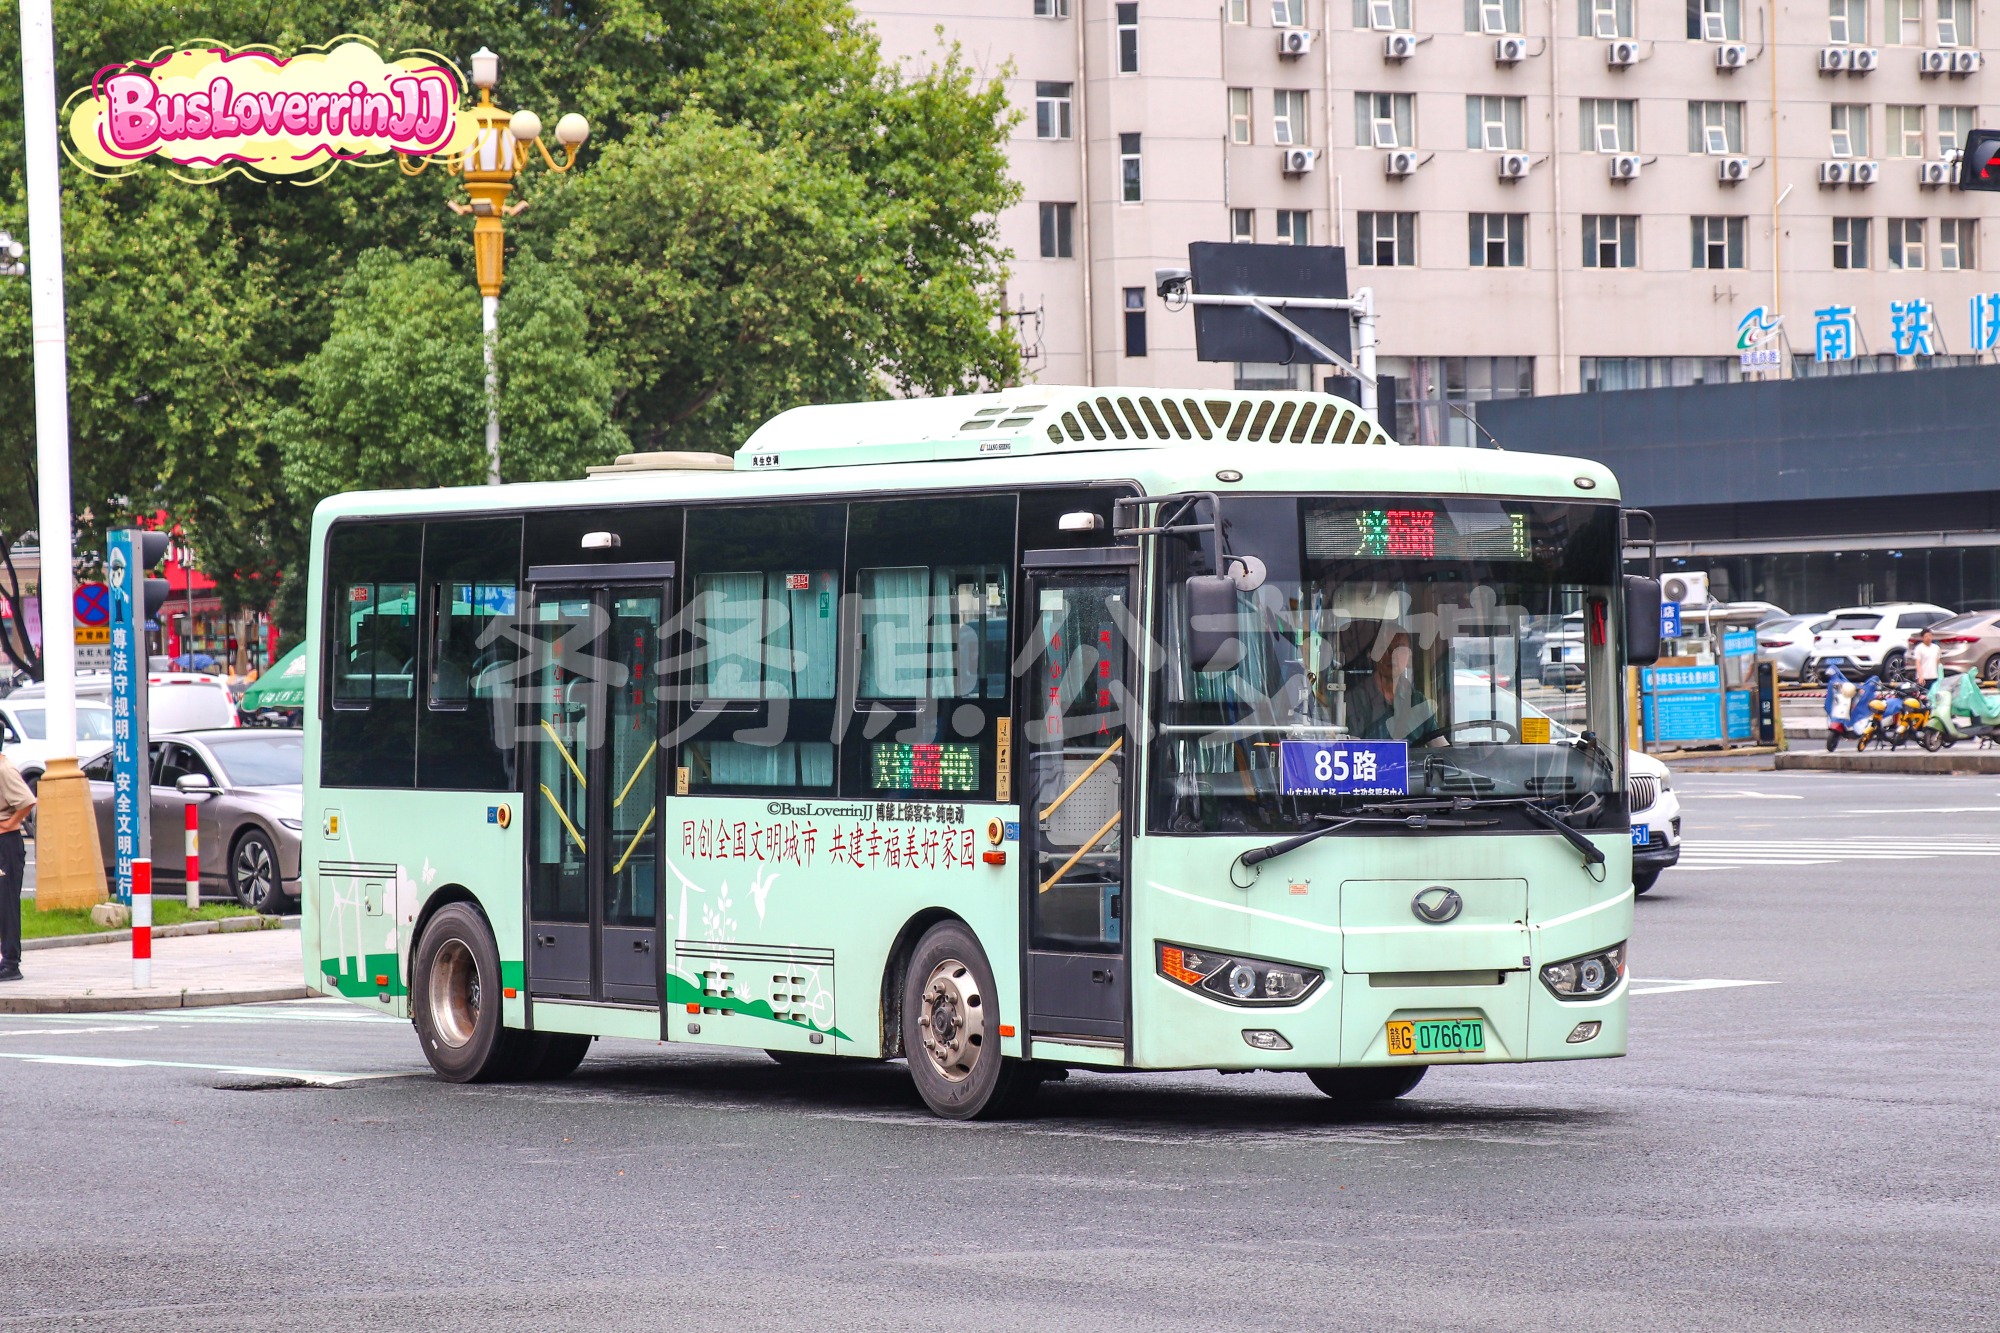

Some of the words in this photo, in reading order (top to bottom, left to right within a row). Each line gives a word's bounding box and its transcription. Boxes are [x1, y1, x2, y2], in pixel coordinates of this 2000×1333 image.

[752, 455, 779, 466] 良生空调
[112, 628, 130, 763] 尊法守规明礼
[1314, 750, 1377, 781] 85路
[116, 772, 132, 897] 安全文明出行
[682, 818, 818, 868] 同创全国文明城市
[829, 821, 976, 871] 共建幸福美好家园
